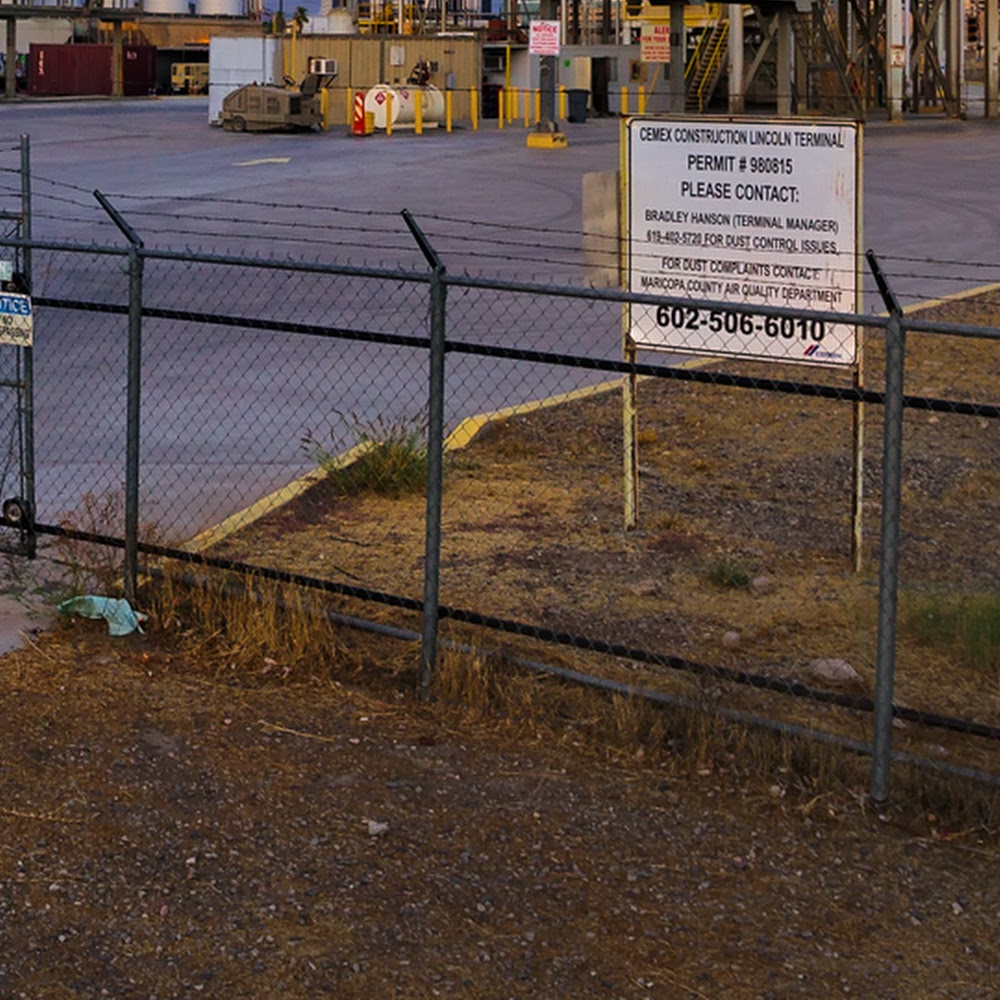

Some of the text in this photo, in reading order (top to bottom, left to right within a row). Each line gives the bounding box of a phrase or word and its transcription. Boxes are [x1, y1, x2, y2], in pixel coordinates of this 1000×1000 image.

[639, 127, 844, 148] CEMEX CONSTRUCTION LINCOLN TERMINAL
[688, 154, 793, 175] PERMIT # 980815
[681, 181, 800, 203] PLEASE CONTACT:
[645, 209, 839, 235] BRADLEY HANSON (TERMINAL MANAGER)
[704, 233, 724, 246] FOR
[726, 235, 750, 247] DUST
[753, 236, 798, 252] CONTROL
[662, 257, 681, 270] FOR
[682, 259, 708, 272] DUST
[709, 261, 770, 277] COMPLAINTS
[641, 276, 842, 304] MARICOPA COUNTY AIR QUALITY DEPARTMENT
[656, 306, 825, 341] 602-506-6010
